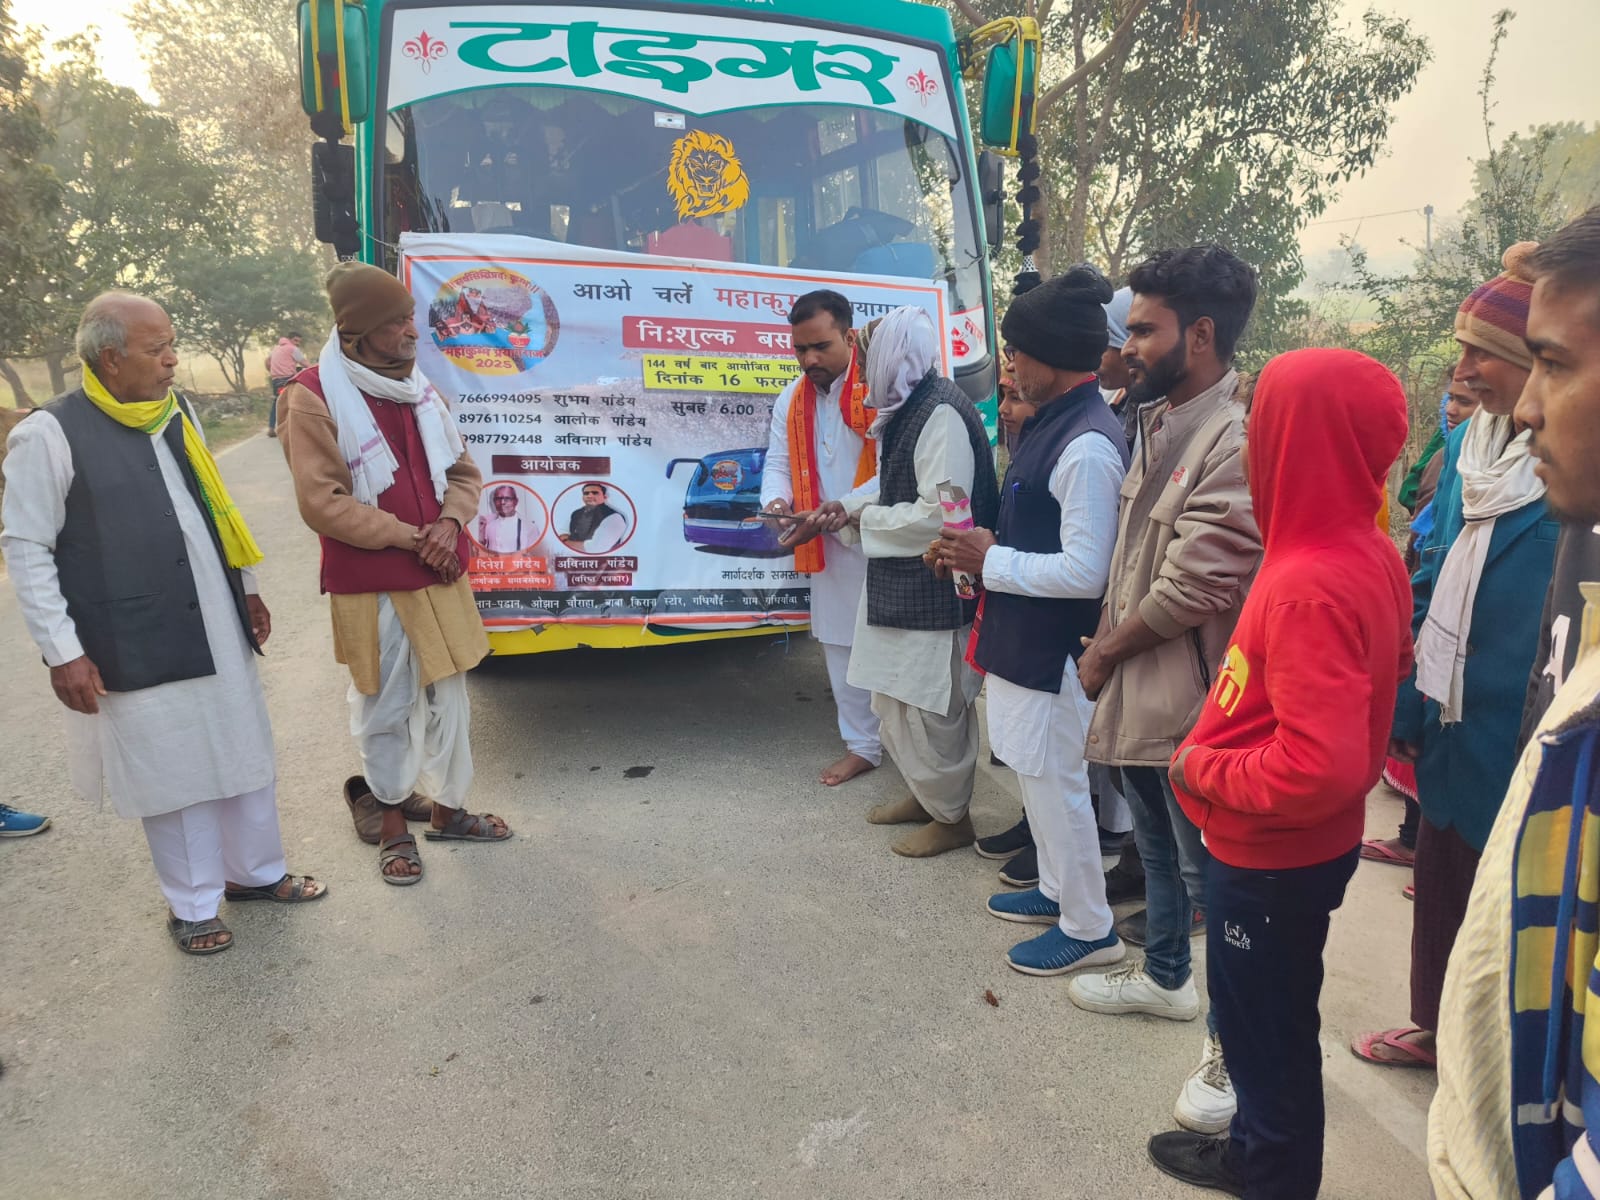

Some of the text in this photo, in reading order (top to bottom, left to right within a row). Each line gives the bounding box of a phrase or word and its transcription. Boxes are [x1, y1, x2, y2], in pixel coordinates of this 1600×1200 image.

[449, 21, 900, 105] टाइगर
[573, 279, 632, 302] आओ
[653, 281, 693, 305] चलें
[475, 358, 512, 369] 2025
[647, 359, 666, 369] 144
[675, 357, 692, 370] वर्ष
[700, 359, 718, 371] बाद
[726, 360, 770, 373] आयोजित
[654, 369, 705, 386] दिनांक
[720, 373, 741, 387] 16
[458, 393, 637, 408] 7666994095 शुभम पांडेय
[671, 398, 706, 416] सुबह
[720, 402, 754, 416] 6.00
[458, 412, 647, 428] 8976110254 आलोक पांडेय
[553, 432, 607, 446] अविनाश
[617, 433, 653, 448] पांडेय
[520, 456, 581, 472] आयोजक
[476, 558, 541, 571] दिनेश पांडेय
[557, 558, 635, 570] अविनाश पांडेय
[721, 566, 766, 581] मार्गदर्शक
[771, 569, 799, 580] समस्त
